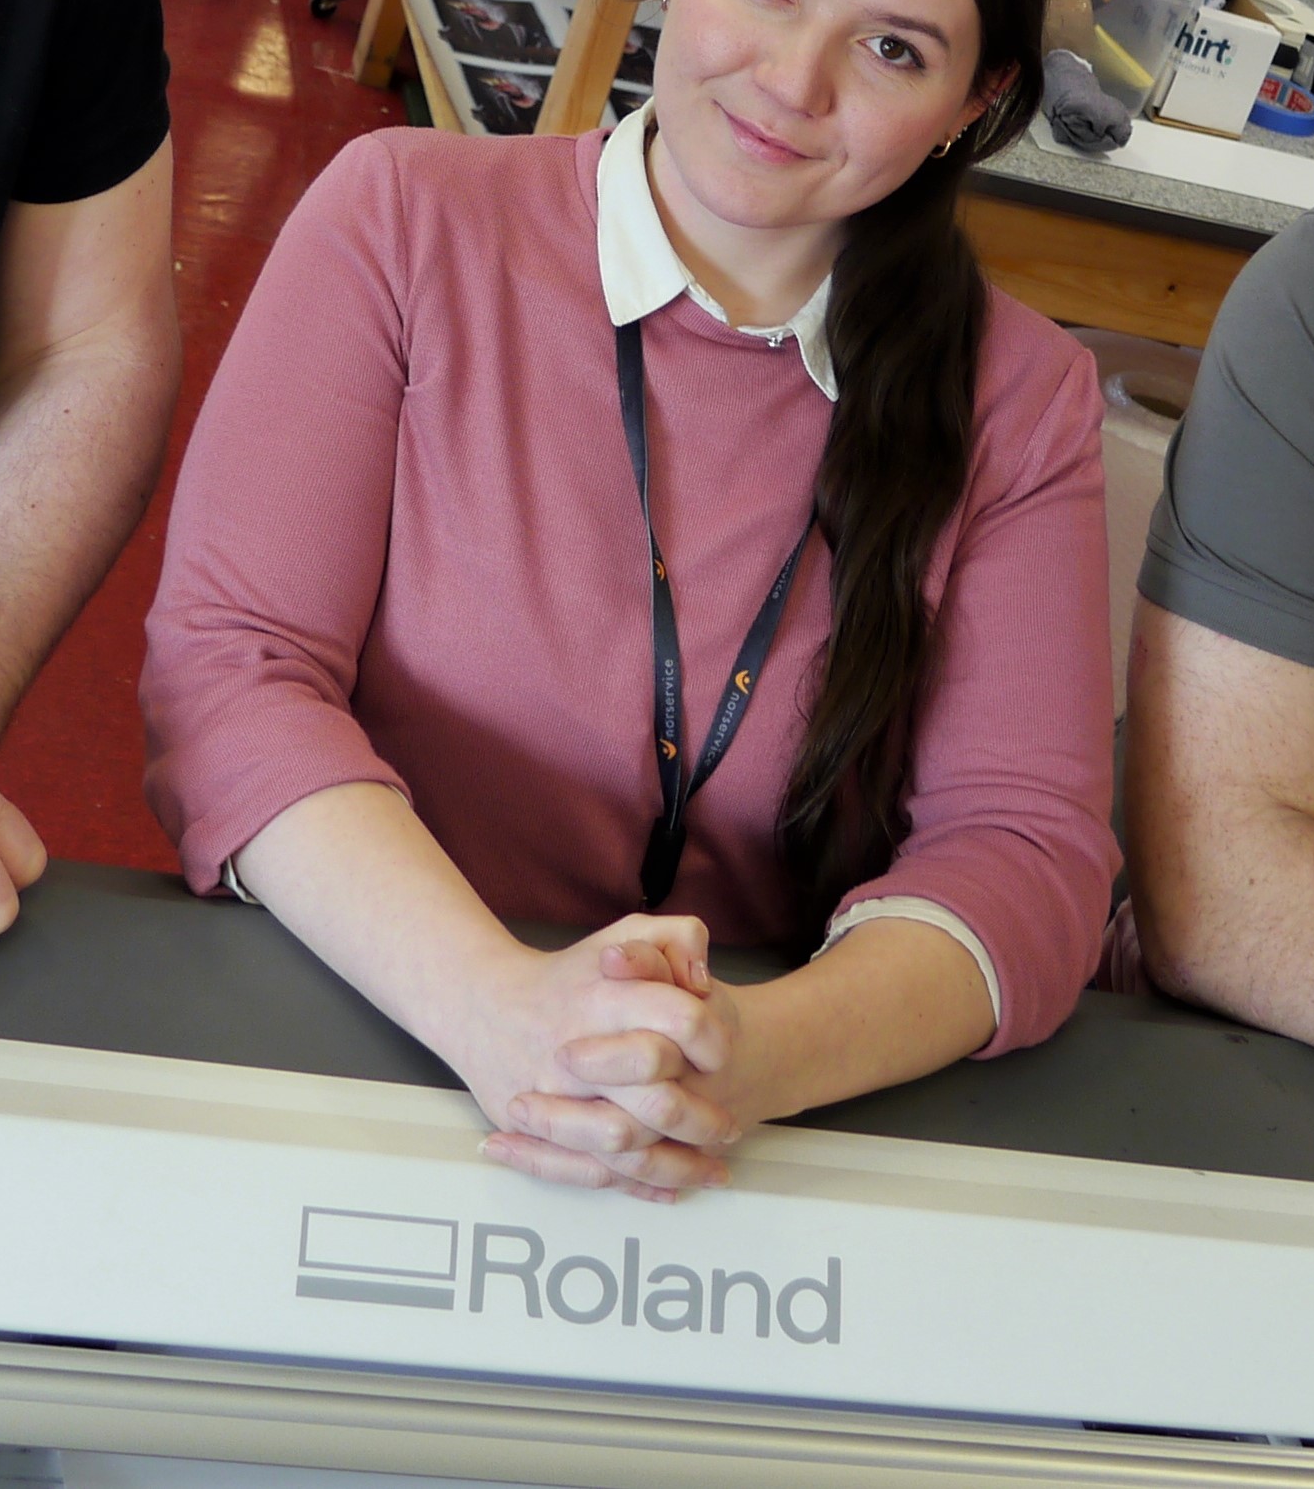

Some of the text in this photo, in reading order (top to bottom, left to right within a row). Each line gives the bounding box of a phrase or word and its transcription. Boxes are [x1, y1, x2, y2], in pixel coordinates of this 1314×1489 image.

[663, 658, 675, 738] norservice
[705, 691, 740, 766] norservice
[469, 1222, 842, 1345] Roland
